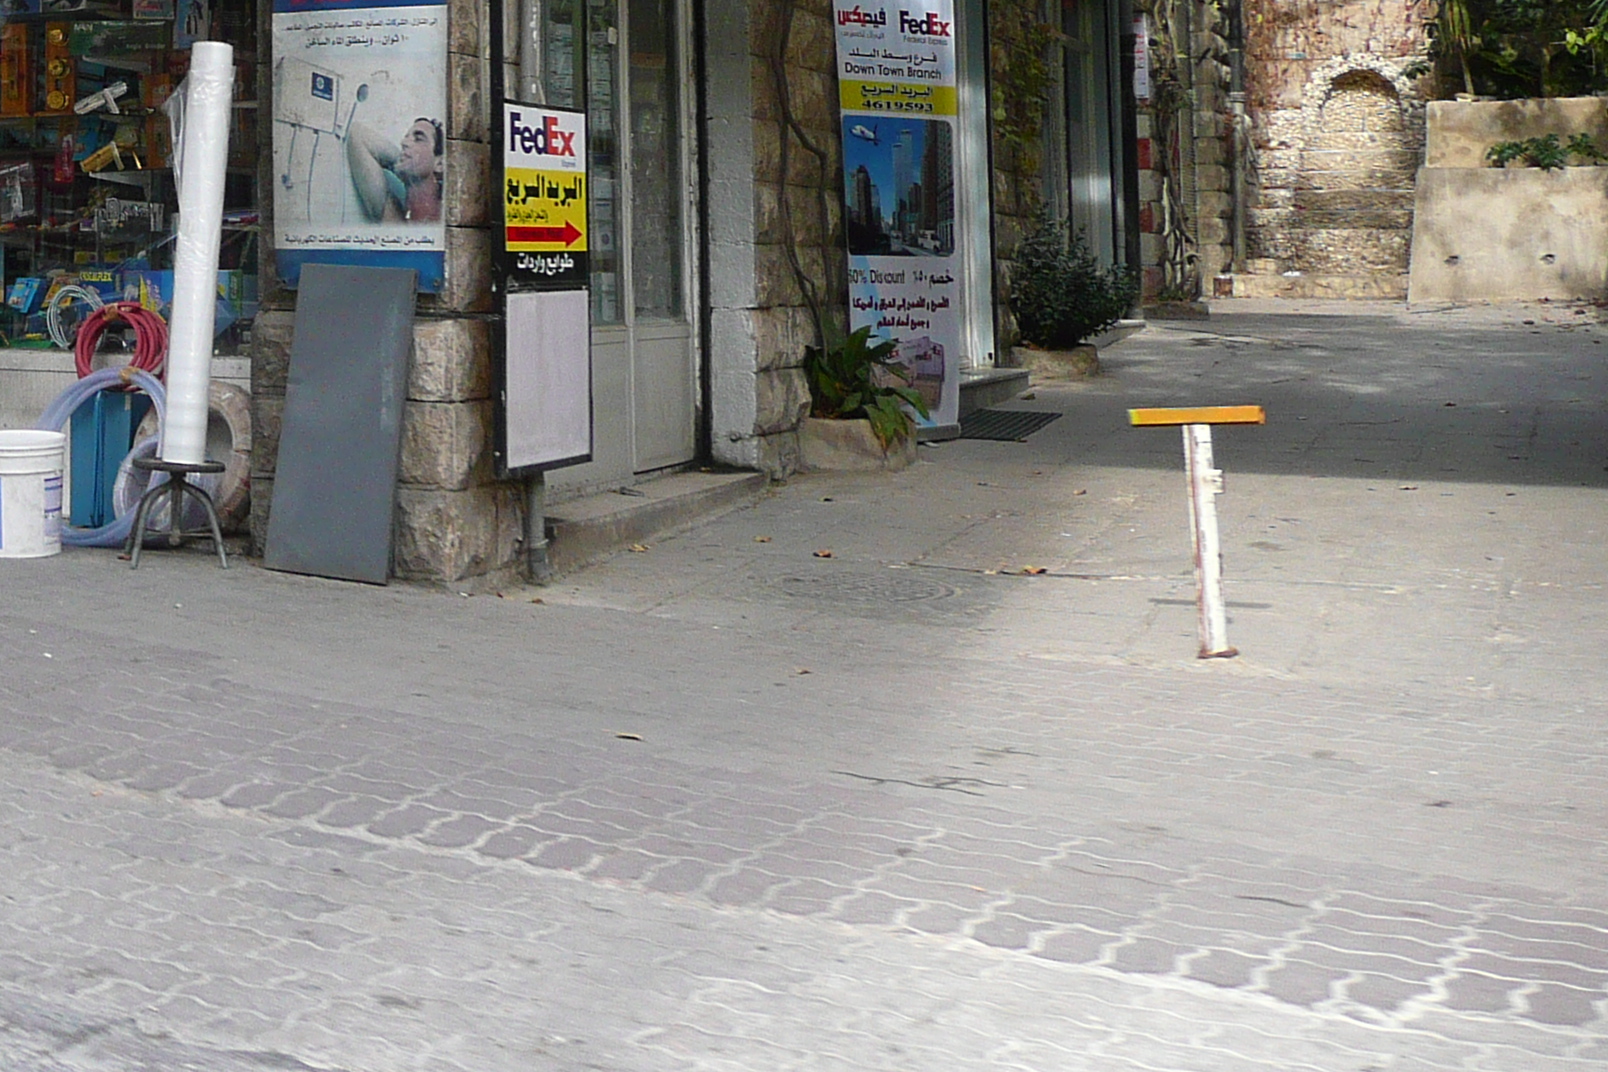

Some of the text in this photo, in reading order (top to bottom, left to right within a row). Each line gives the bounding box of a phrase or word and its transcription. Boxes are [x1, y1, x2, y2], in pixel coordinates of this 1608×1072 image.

[899, 10, 951, 37] FedEx
[844, 61, 942, 80] Down Town Branch
[861, 99, 934, 113] 4619593
[509, 111, 577, 158] FedEx
[506, 173, 582, 207] البريد السريع
[869, 269, 906, 285] Discount
